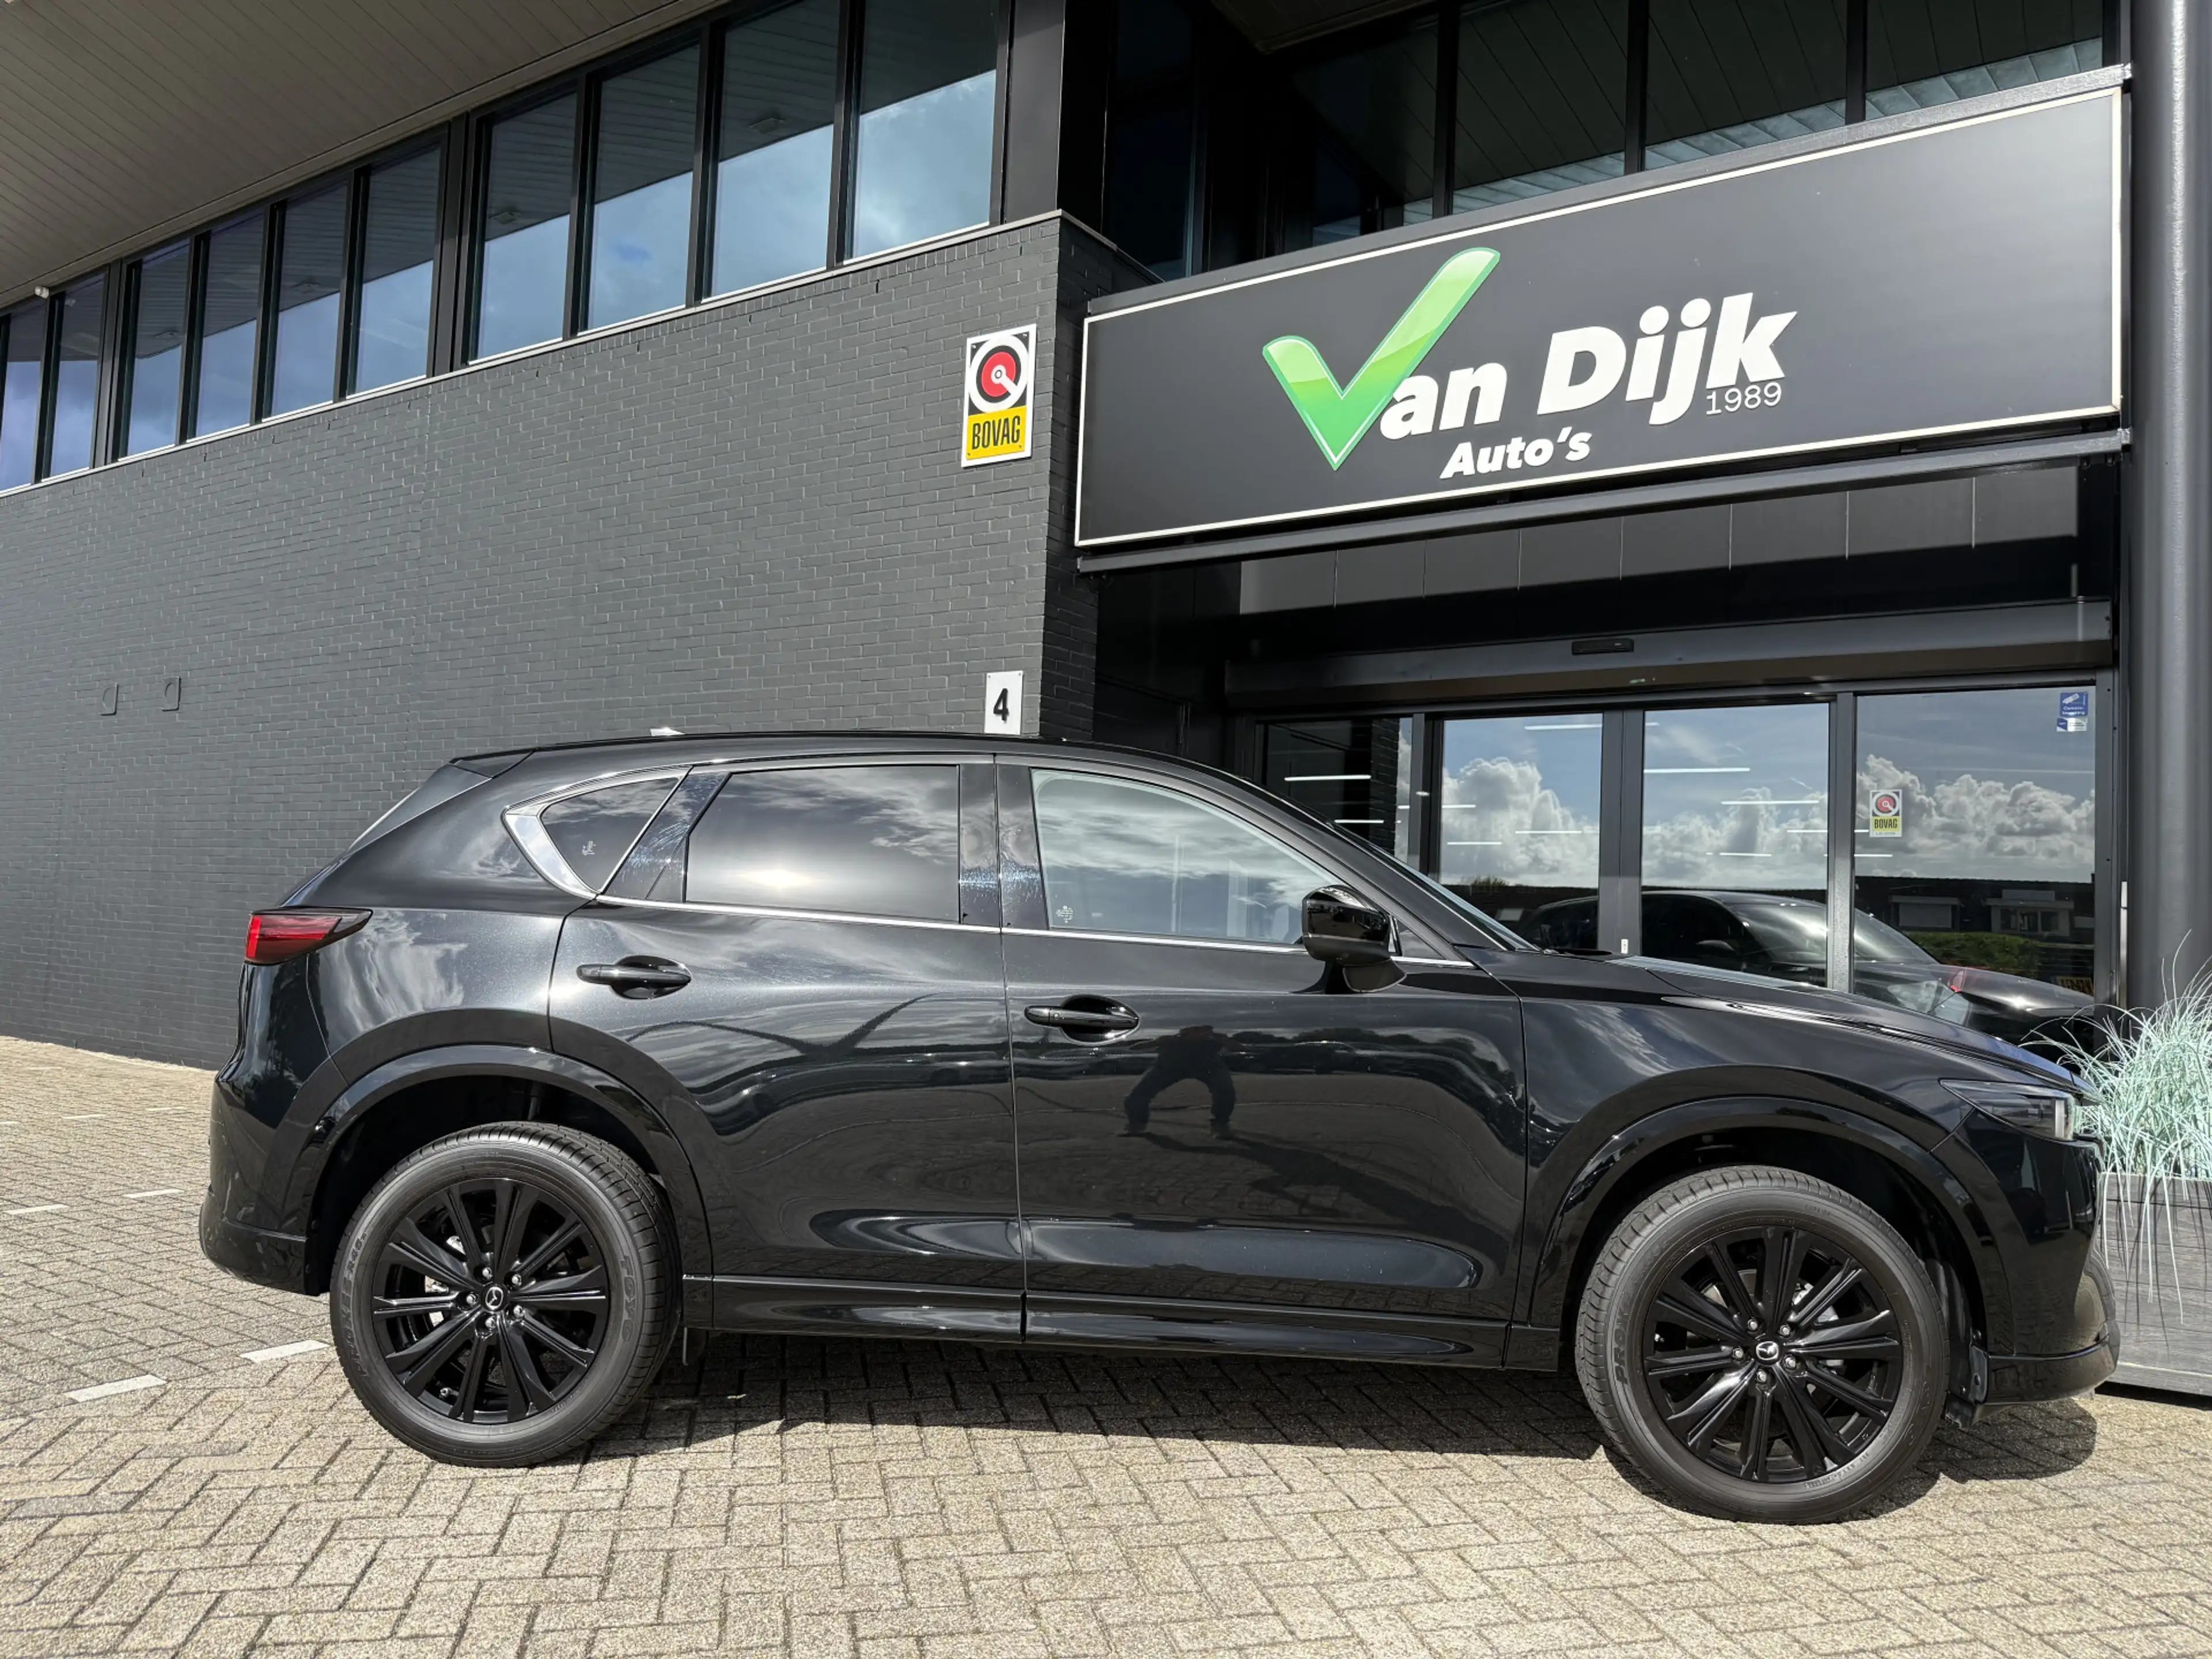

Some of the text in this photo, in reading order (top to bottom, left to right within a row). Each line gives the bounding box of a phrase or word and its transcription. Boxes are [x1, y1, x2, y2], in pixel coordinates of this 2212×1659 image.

[1537, 292, 1797, 425] Dijk
[1705, 382, 1782, 416] 1989
[972, 415, 1021, 450] BOVAG
[1440, 428, 1592, 479] Auto's
[993, 687, 1009, 721] 4
[1874, 818, 1897, 829] BOVAG
[620, 1255, 636, 1341] TOYO
